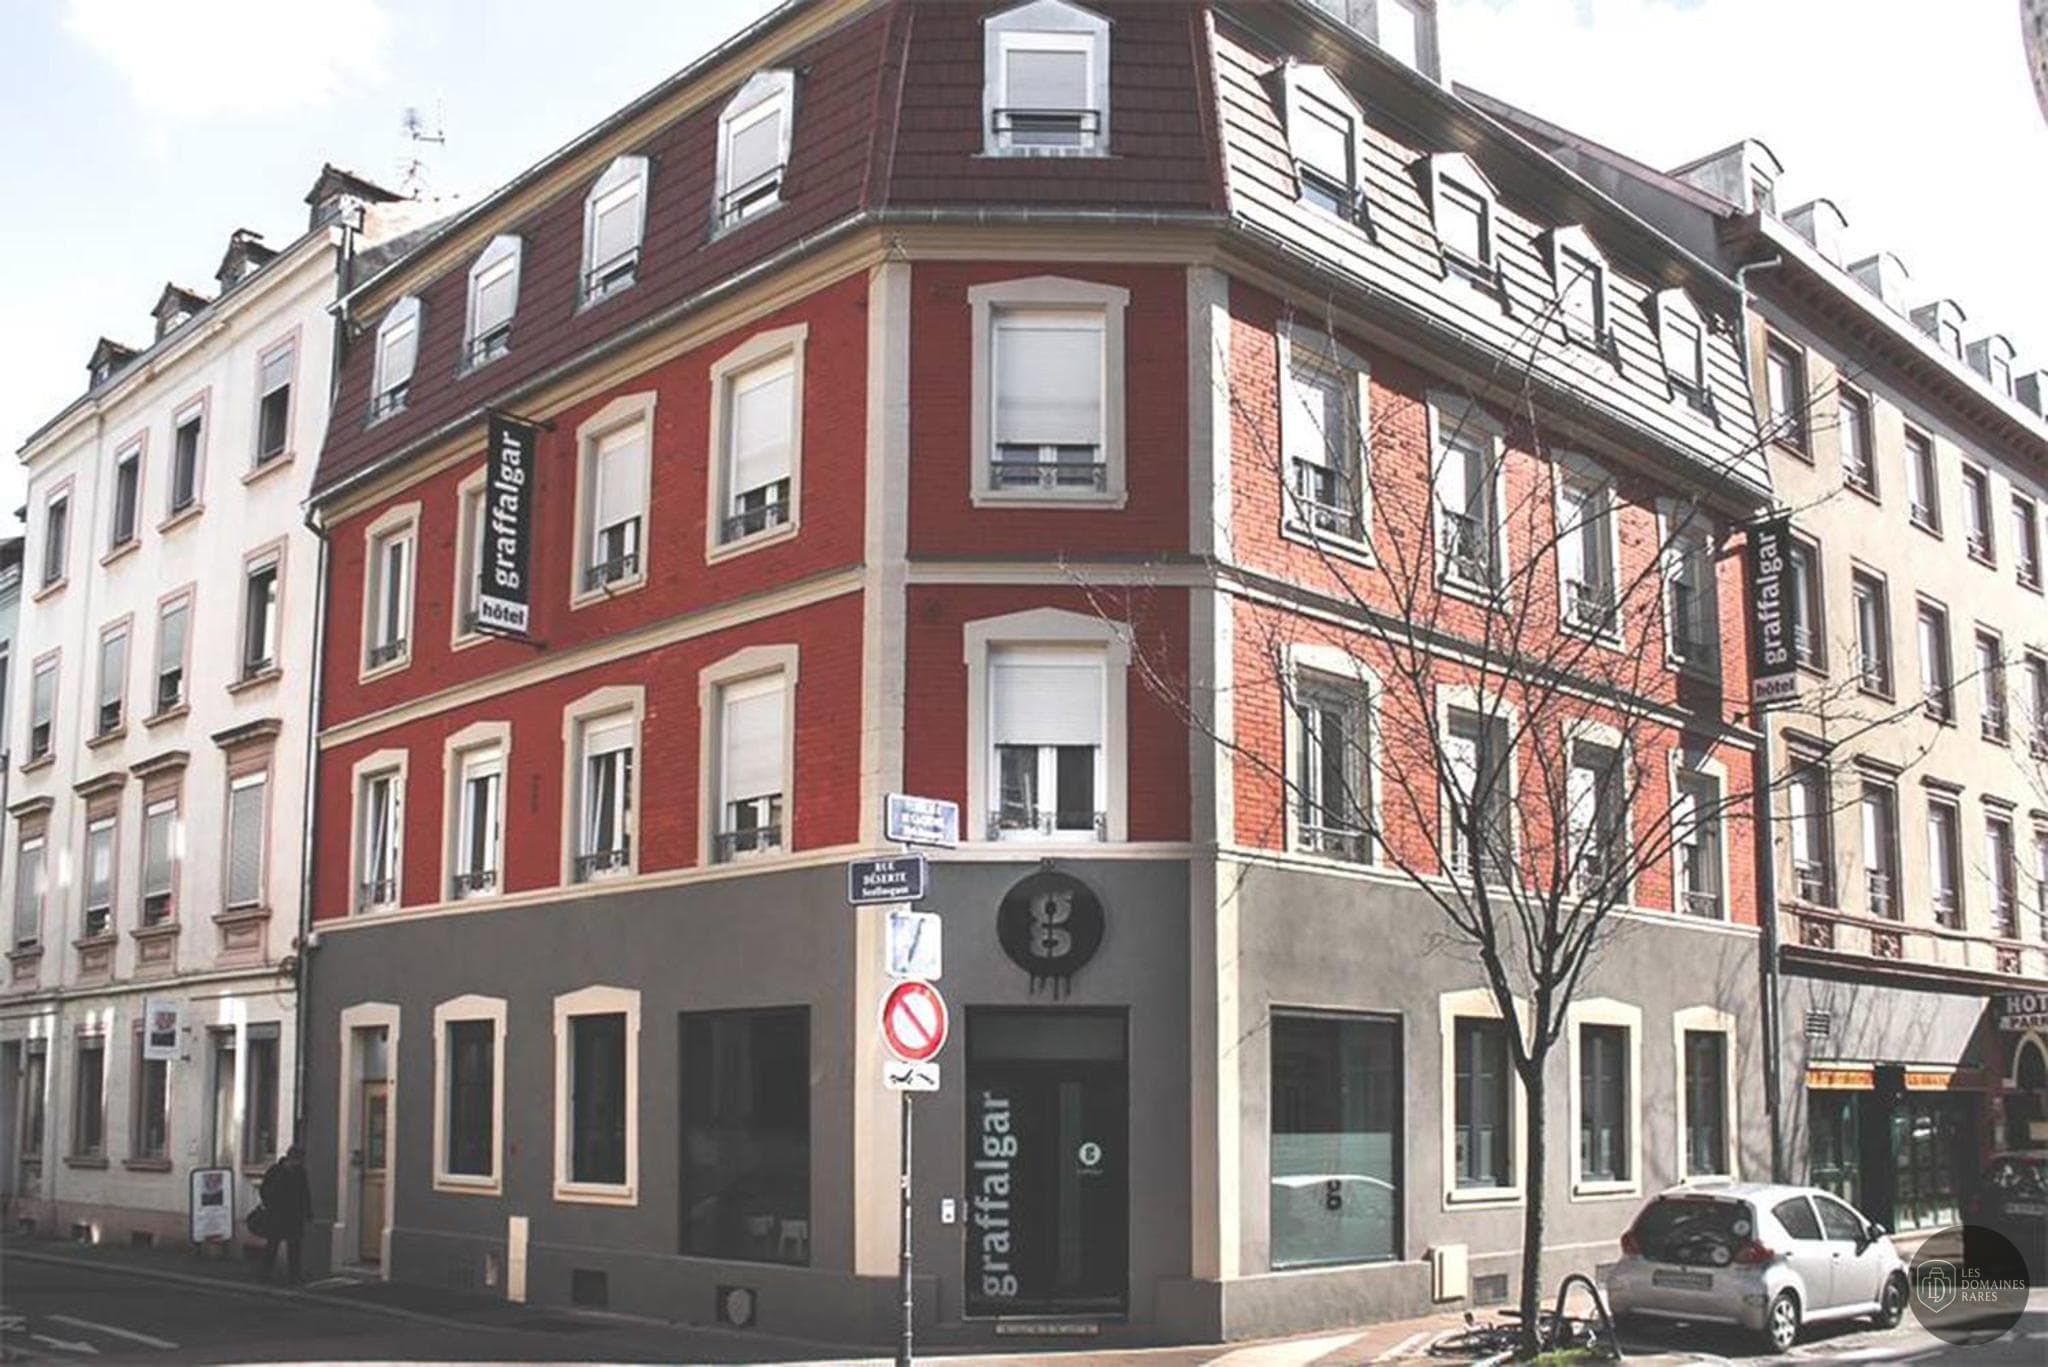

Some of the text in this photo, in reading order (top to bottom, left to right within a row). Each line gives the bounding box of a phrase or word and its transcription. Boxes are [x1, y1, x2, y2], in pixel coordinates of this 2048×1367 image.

[491, 431, 525, 589] graffalgar
[482, 603, 524, 625] hôtel
[1756, 532, 1788, 664] graffalgar
[1756, 679, 1795, 698] hôtel
[974, 1091, 1018, 1296] graffalgar
